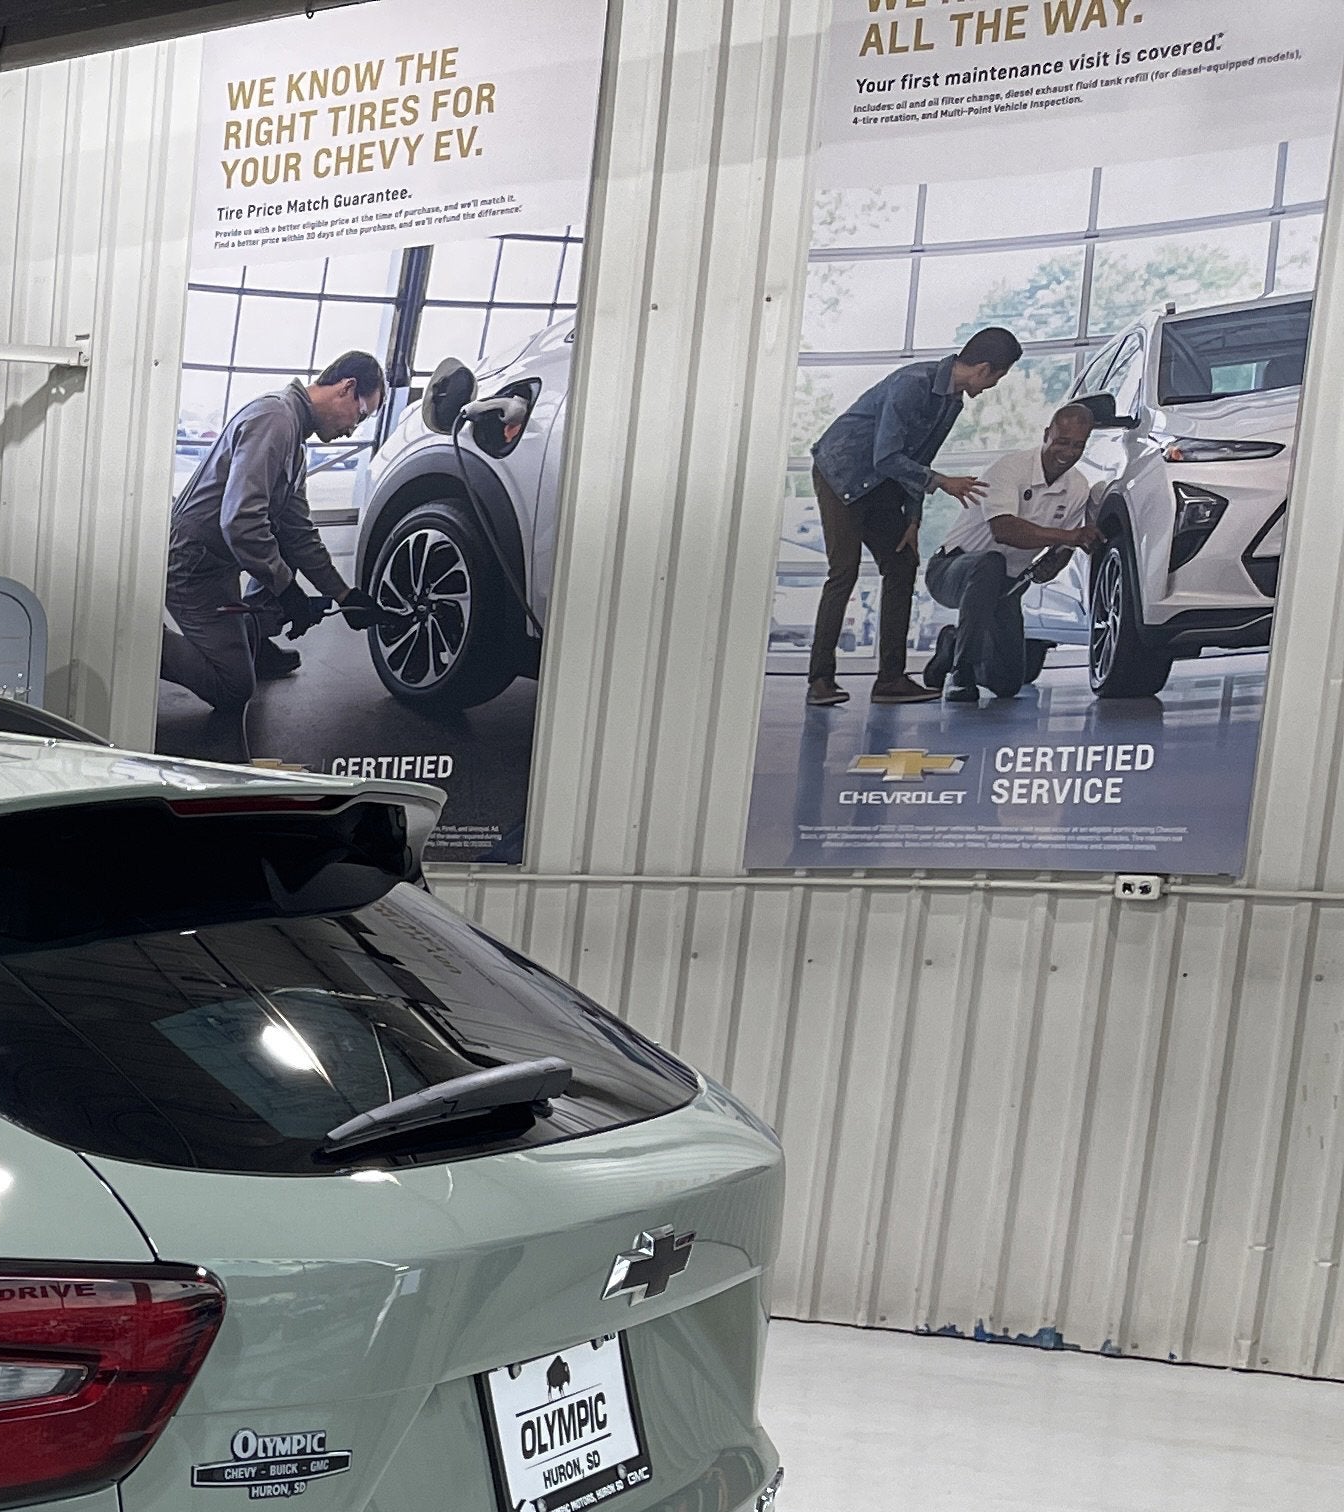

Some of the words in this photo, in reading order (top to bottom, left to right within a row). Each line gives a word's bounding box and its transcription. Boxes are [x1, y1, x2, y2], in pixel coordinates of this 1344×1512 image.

[859, 17, 935, 57] ALL
[949, 4, 1029, 48] THE
[1043, 0, 1144, 36] WAY.
[227, 75, 277, 111] WE
[286, 59, 385, 103] KNOW
[395, 46, 460, 86] THE
[853, 102, 894, 114] Includes:
[895, 99, 908, 110] oil
[908, 98, 927, 109] and
[928, 97, 940, 107] oil
[941, 95, 965, 106] filter
[966, 91, 1003, 104] change,
[1004, 87, 1034, 99] diesel
[1035, 83, 1074, 97] exhaust
[1075, 79, 1098, 91] fluid
[1100, 76, 1123, 88] tank
[1124, 72, 1149, 85] refill
[1150, 70, 1170, 83] (for
[1171, 57, 1255, 79] diesel-equipped
[855, 78, 897, 95] Your
[900, 72, 940, 90] first
[944, 57, 1064, 87] maintenance
[1069, 50, 1110, 71] visit
[1115, 48, 1131, 66] is
[223, 109, 319, 151] RIGHT
[327, 93, 421, 138] TIRES
[431, 82, 497, 122] FOR
[852, 114, 879, 126] 4-tire
[880, 111, 920, 124] rotation,
[920, 110, 939, 121] and
[940, 106, 992, 118] Multi-Point
[993, 101, 1028, 114] Vehicle
[1029, 94, 1084, 111] Inspection.
[220, 151, 302, 189] YOUR
[313, 132, 425, 179] CHEVY
[433, 125, 484, 162] EV.
[215, 229, 243, 239] Provide
[254, 226, 270, 235] with
[278, 222, 301, 233] better
[302, 219, 329, 231] eligible
[330, 217, 350, 228] price
[351, 216, 360, 224] at
[361, 213, 374, 222] the
[375, 211, 393, 221] time
[395, 209, 403, 218] of
[404, 205, 443, 219] purchase,
[444, 201, 459, 212] and
[480, 194, 506, 206] match
[216, 206, 244, 222] Tire
[246, 202, 284, 218] Price
[286, 194, 330, 214] Match
[333, 187, 413, 209] Guarantee.
[213, 240, 230, 250] Find
[237, 238, 260, 248] better
[261, 236, 280, 248] price
[281, 232, 305, 243] within
[317, 229, 335, 240] days
[336, 228, 345, 237] of
[345, 226, 358, 236] the
[359, 222, 397, 236] purchase,
[399, 219, 413, 230] and
[434, 213, 461, 225] refund
[462, 210, 476, 220] the
[331, 754, 454, 780] CERTIFIED
[995, 742, 1155, 774] CERTIFIED
[838, 790, 968, 806] CHEVROLET
[990, 776, 1124, 805] SERVICE
[232, 1429, 326, 1459] OLYMPIC
[520, 1391, 608, 1460] OLYMPIC
[224, 1466, 257, 1480] CHEVY
[269, 1462, 299, 1476] BUICK
[310, 1459, 330, 1472] GMC
[542, 1457, 585, 1490] HURON,
[586, 1450, 601, 1471] SD
[626, 1466, 650, 1486] GMC
[251, 1482, 293, 1499] HURON,
[293, 1480, 307, 1495] SD
